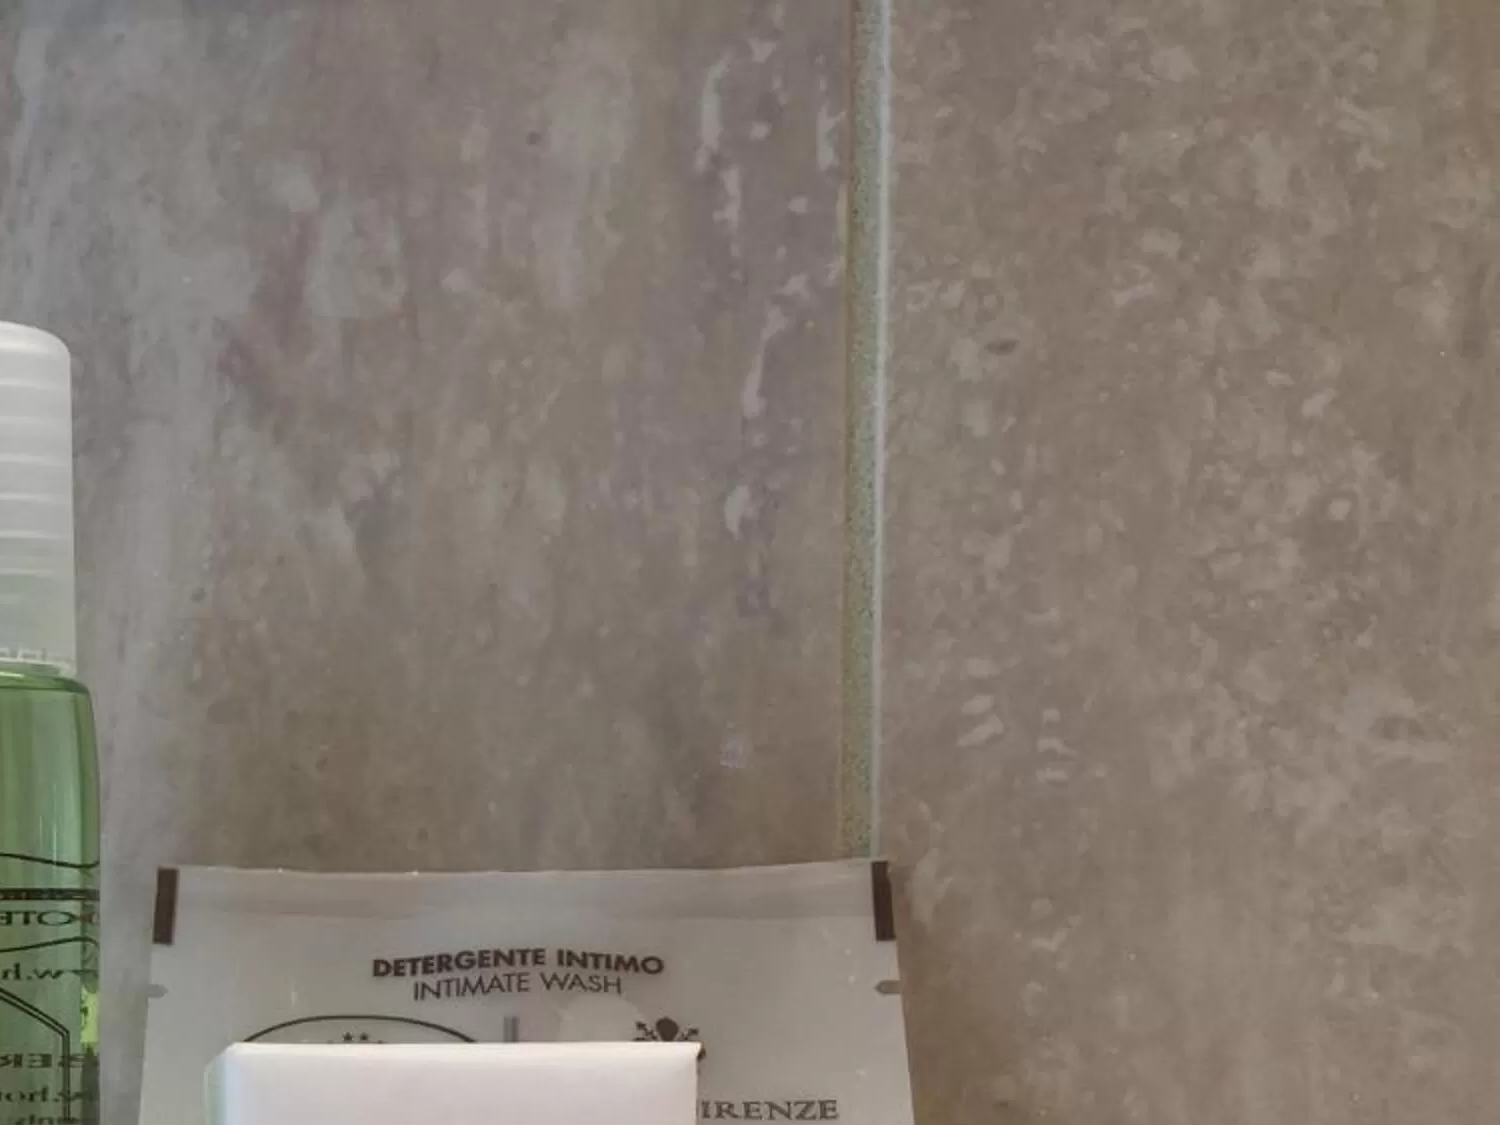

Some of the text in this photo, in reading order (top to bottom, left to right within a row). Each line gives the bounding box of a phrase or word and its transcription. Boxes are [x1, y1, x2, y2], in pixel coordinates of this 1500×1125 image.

[372, 948, 665, 977] DETERGENTE INTIMO
[413, 972, 622, 1001] INTIMATE WASH
[699, 1099, 839, 1121] IRENZE
